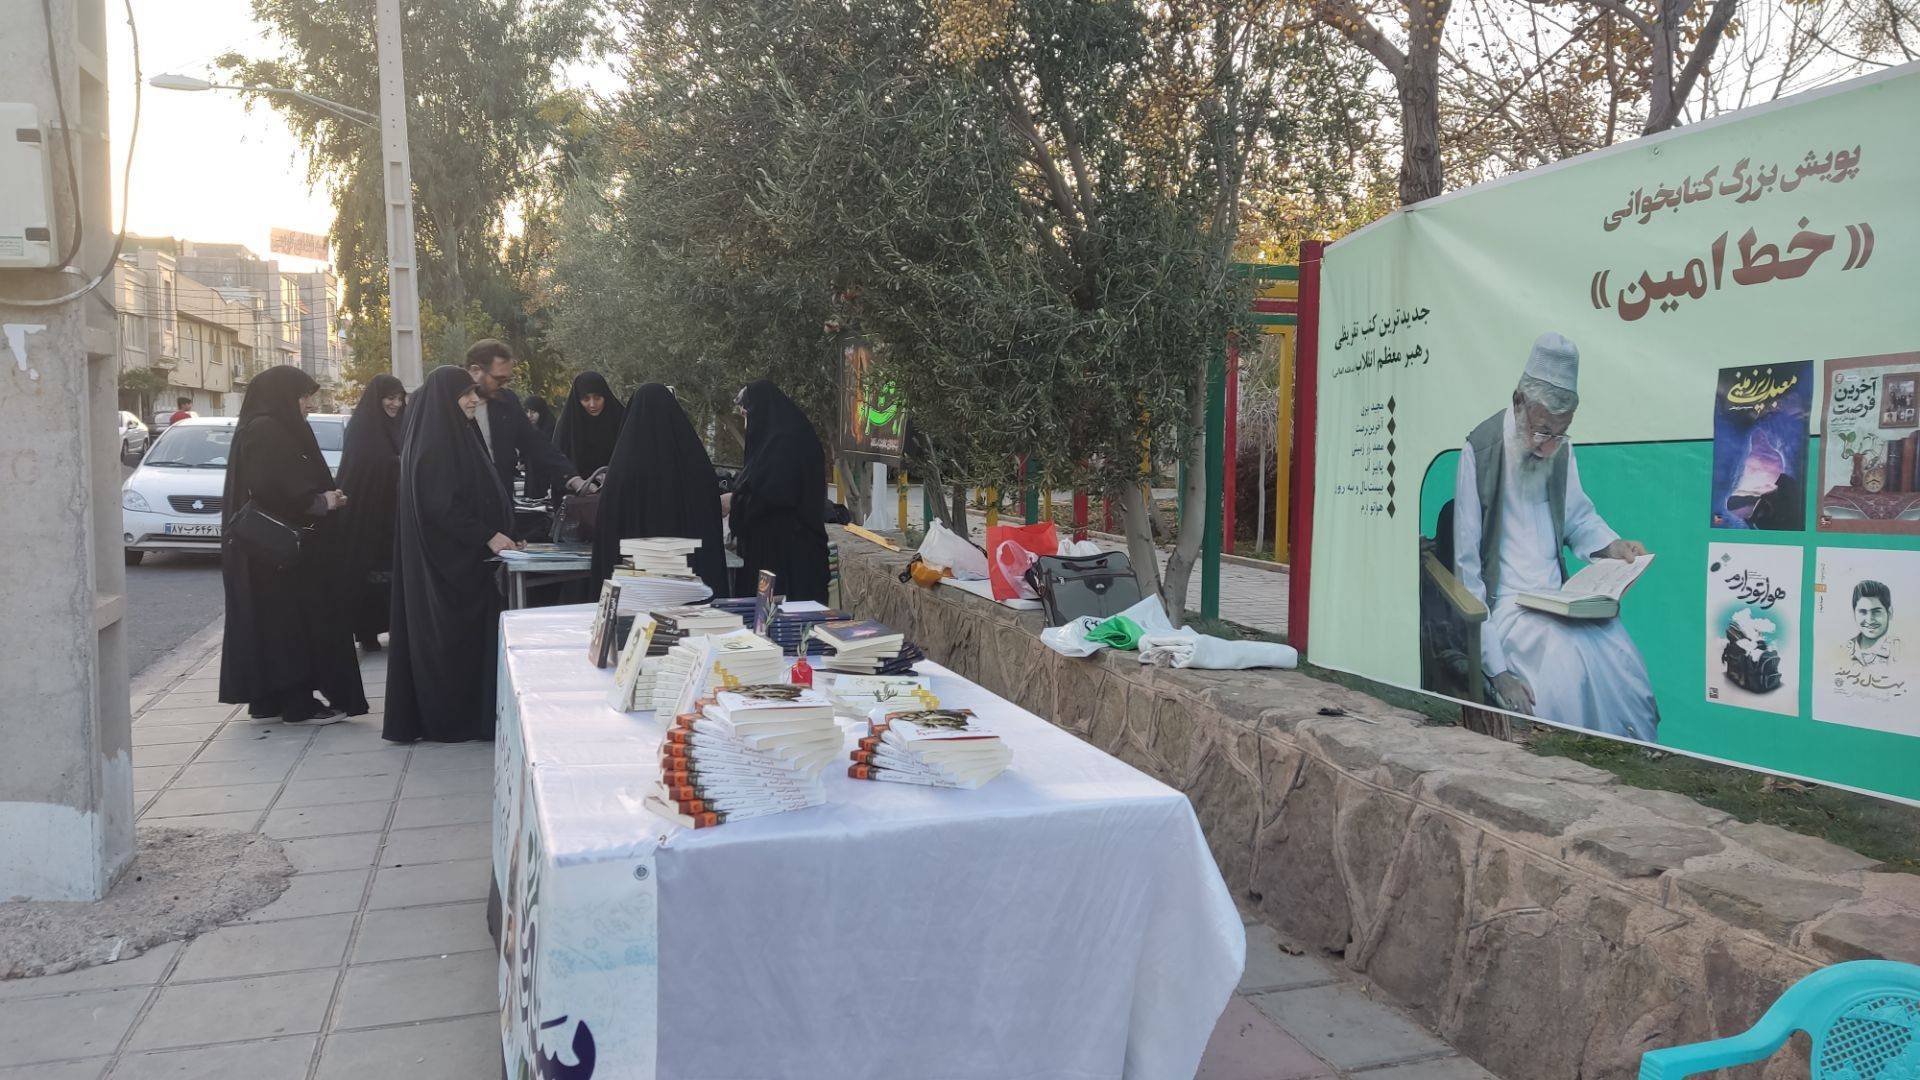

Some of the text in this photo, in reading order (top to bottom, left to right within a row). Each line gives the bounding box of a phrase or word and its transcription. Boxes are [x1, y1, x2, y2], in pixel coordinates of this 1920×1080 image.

[1603, 144, 1862, 232] پویش بزرگ کتابخوانی
[1361, 313, 1377, 340] کتب
[1377, 345, 1402, 372] معظم
[1404, 344, 1429, 368] رهبر
[1834, 376, 1879, 402] آخرین
[1833, 395, 1876, 418] فرصت
